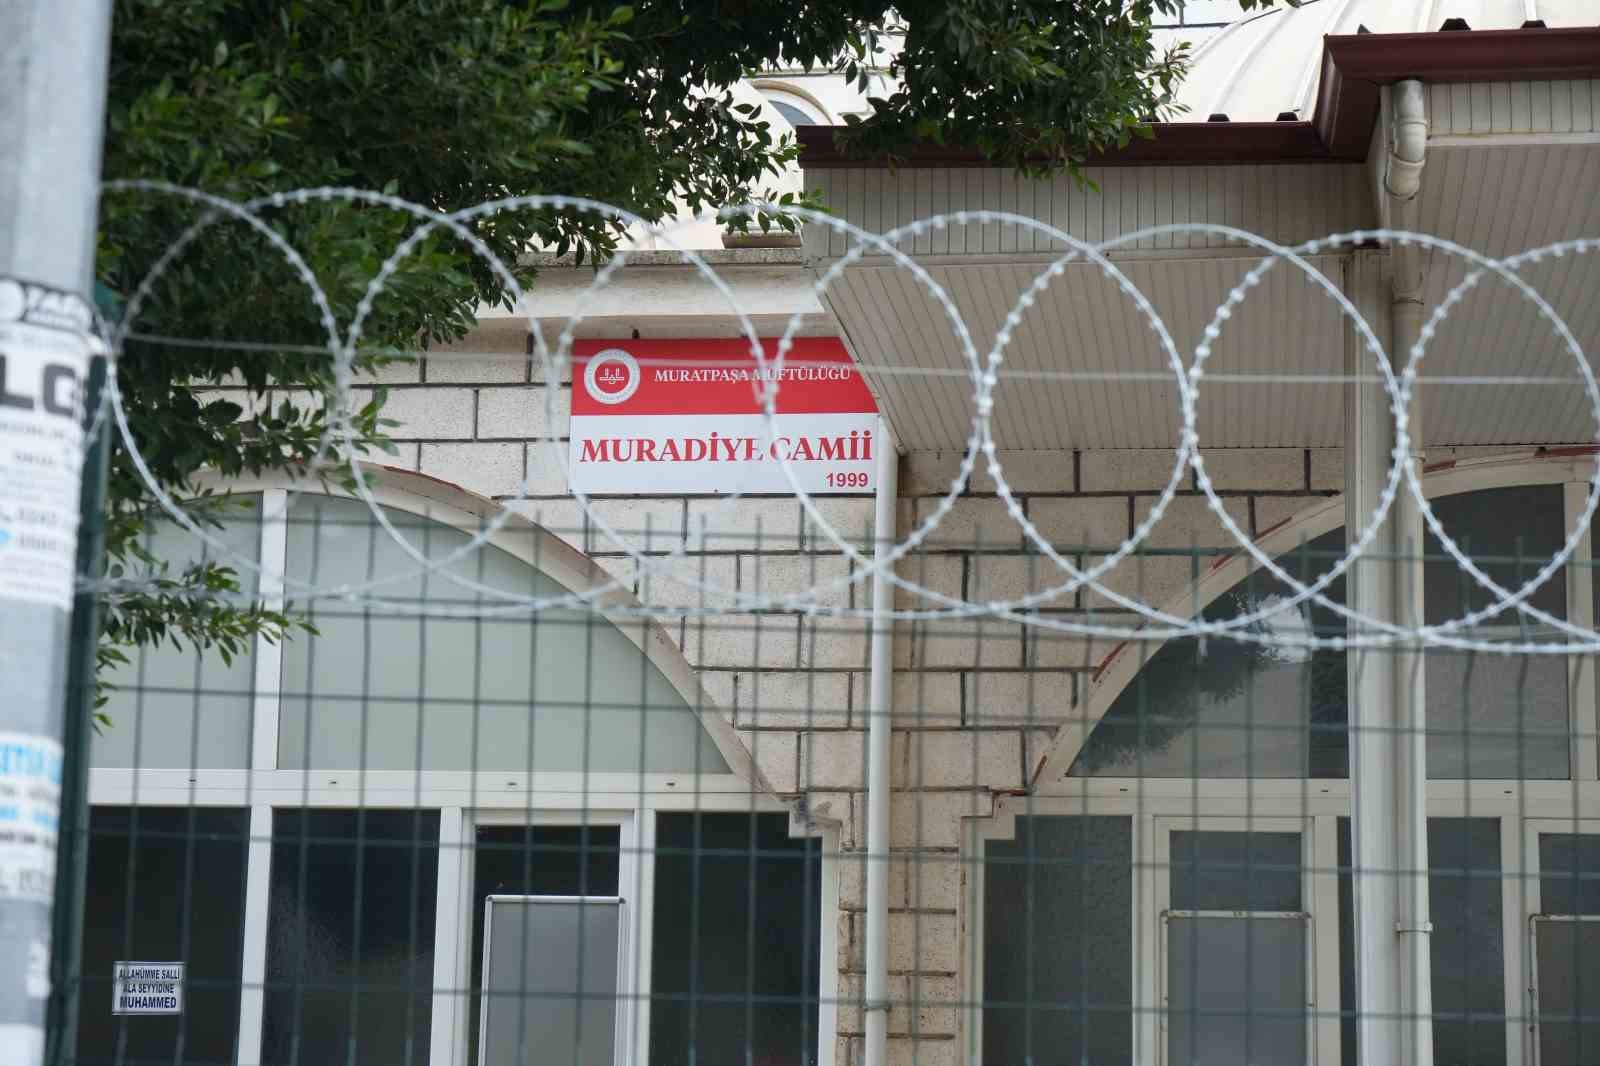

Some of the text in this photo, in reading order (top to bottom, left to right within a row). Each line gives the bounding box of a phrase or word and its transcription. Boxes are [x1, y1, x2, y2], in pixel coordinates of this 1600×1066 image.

[654, 368, 749, 384] MURATPAŞA
[579, 430, 873, 462] MURADİYE CAMİİ
[825, 471, 869, 488] 1999
[120, 996, 177, 1009] MUHAMMED
